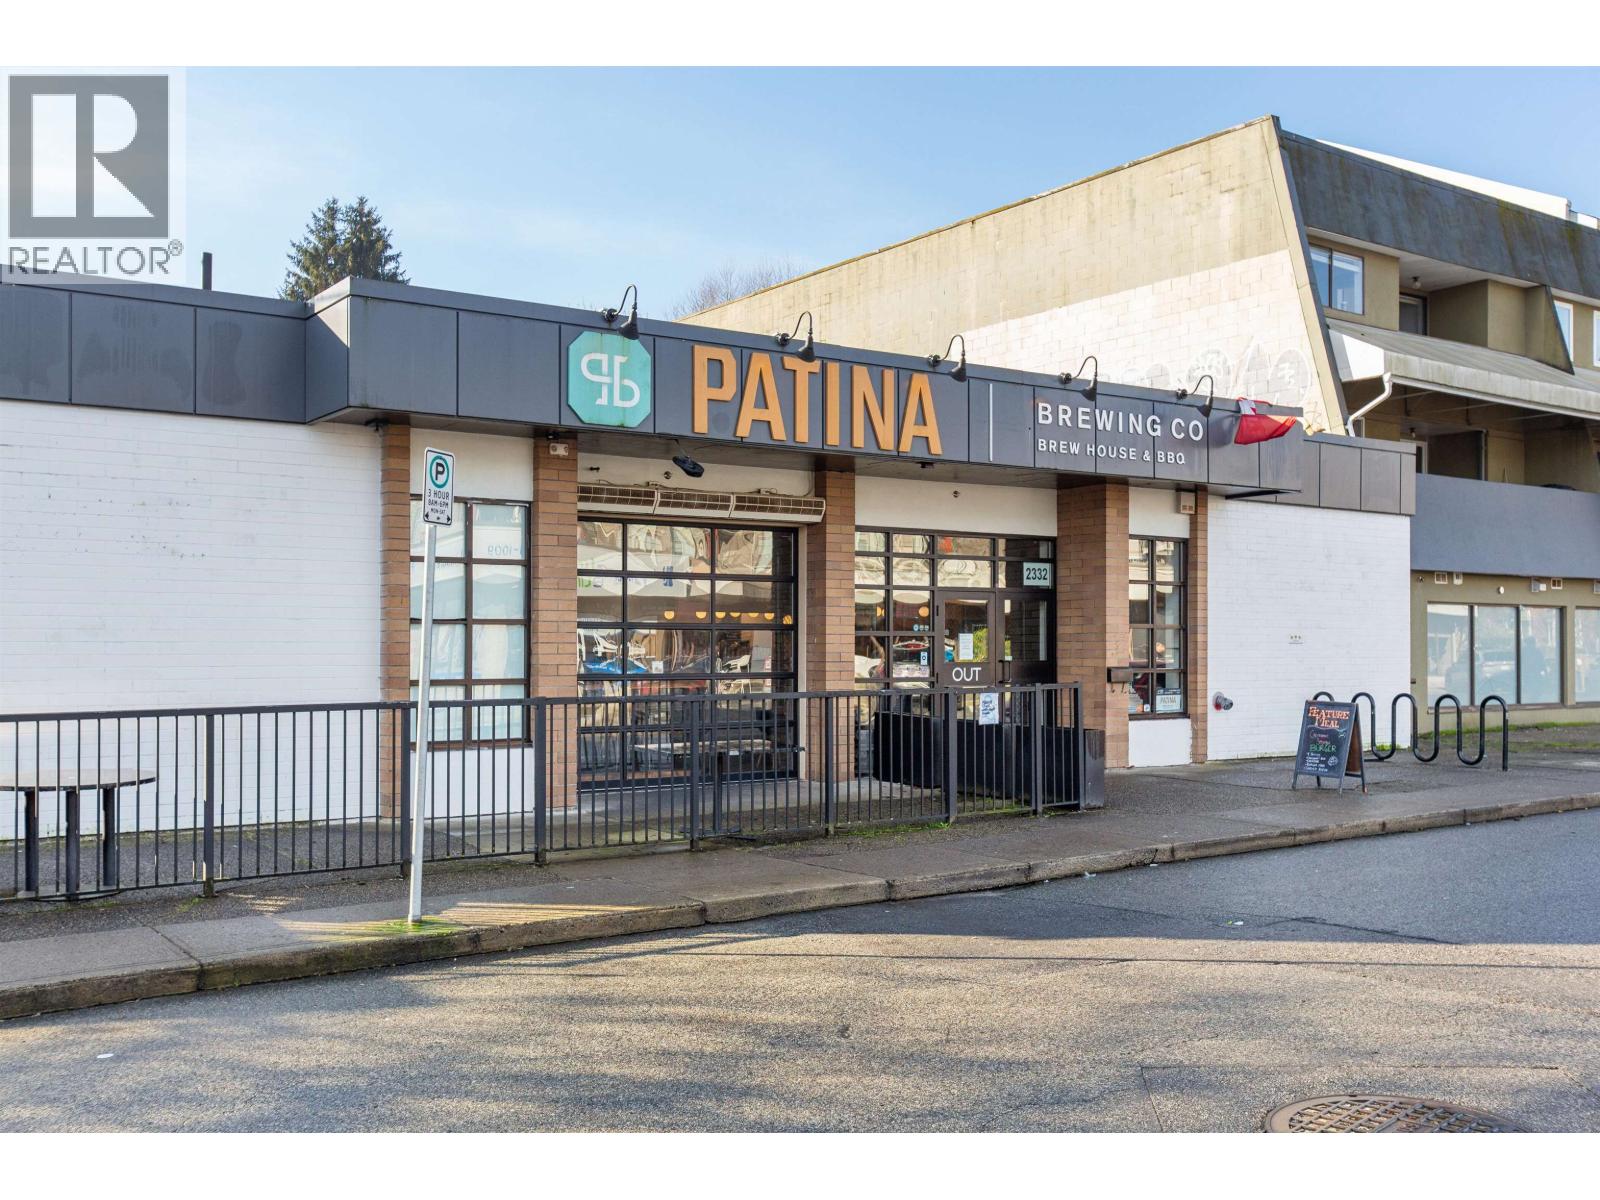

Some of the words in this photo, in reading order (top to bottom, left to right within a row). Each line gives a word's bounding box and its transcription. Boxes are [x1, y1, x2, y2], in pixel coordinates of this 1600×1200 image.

[692, 344, 943, 455] PATINA
[1038, 402, 1162, 437] BREWING
[1171, 418, 1204, 441] CO
[1038, 438, 1080, 455] BREW
[1086, 443, 1137, 460] HOUSE
[1143, 450, 1151, 461] &
[1157, 451, 1185, 465] BBQ
[435, 462, 446, 481] P
[428, 489, 432, 497] 3
[434, 490, 449, 500] HOUR
[1026, 567, 1048, 580] 2332
[952, 667, 981, 681] OUT
